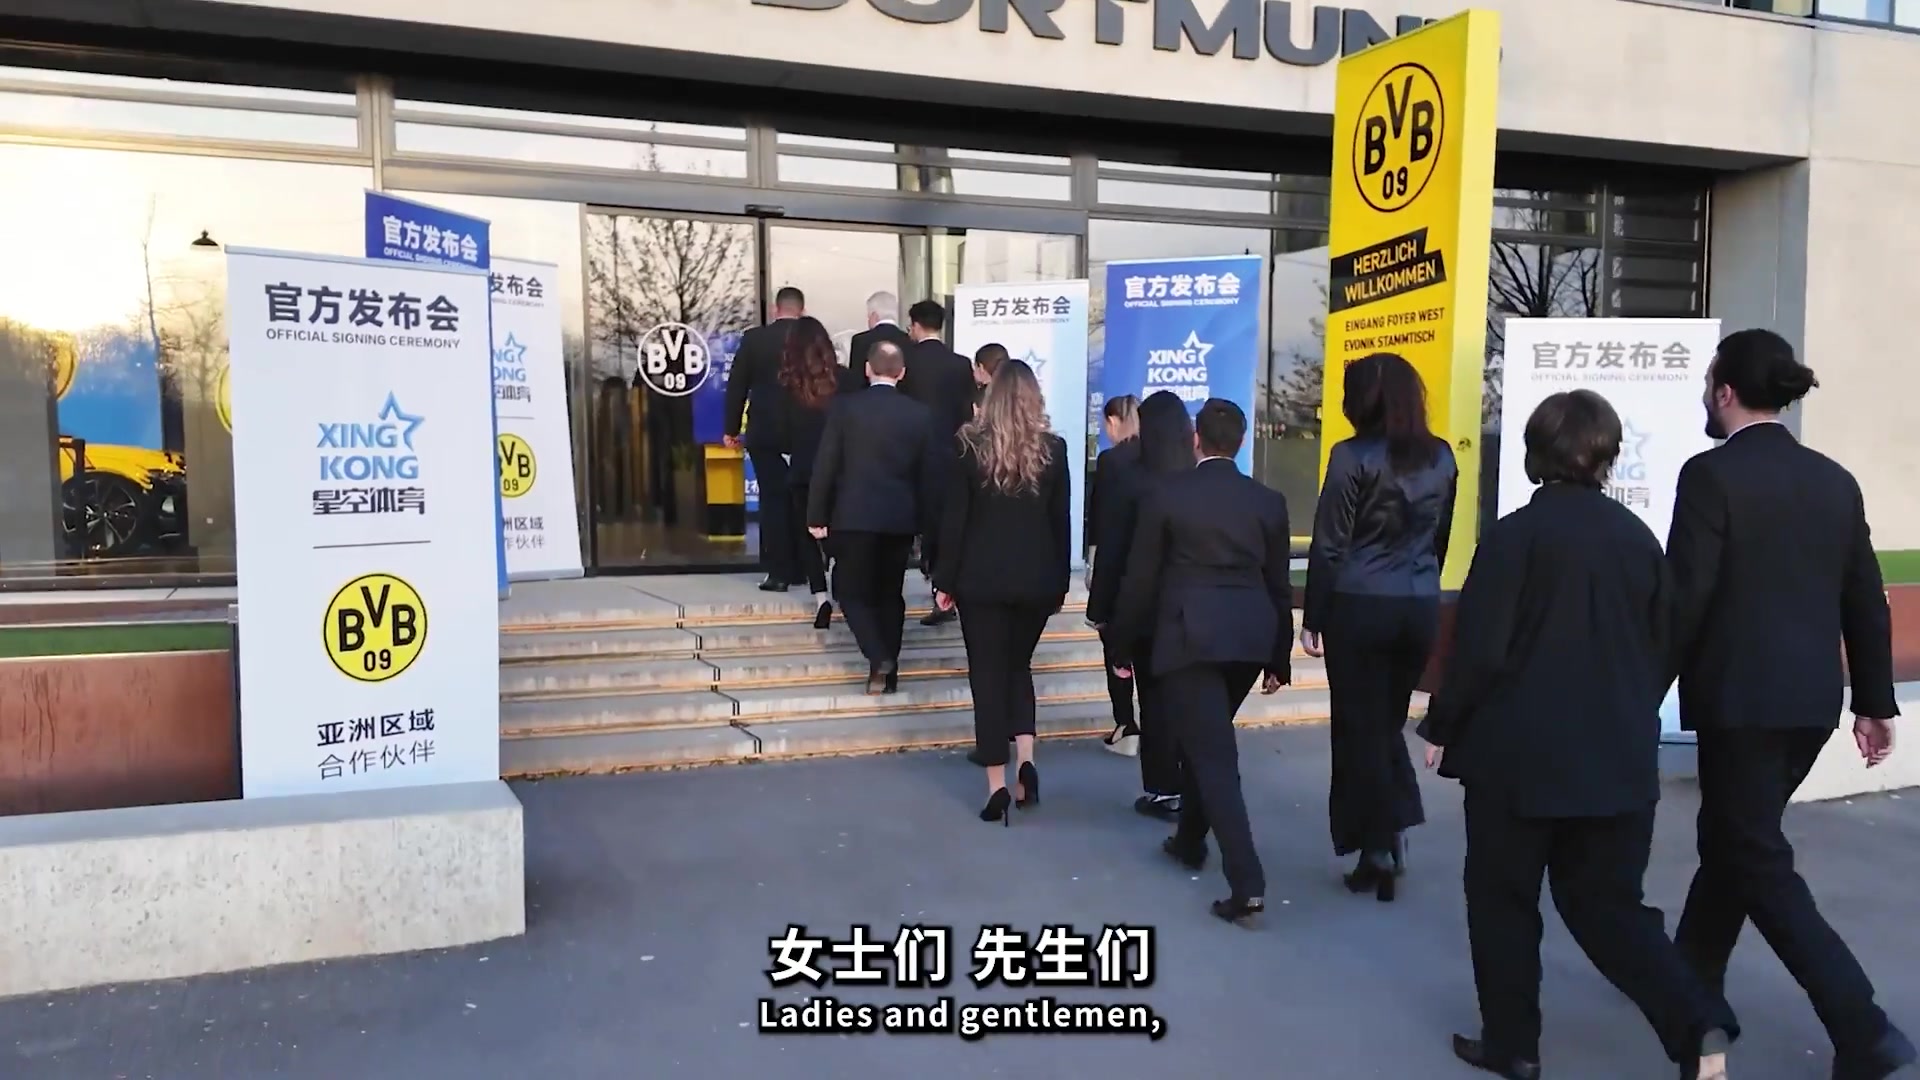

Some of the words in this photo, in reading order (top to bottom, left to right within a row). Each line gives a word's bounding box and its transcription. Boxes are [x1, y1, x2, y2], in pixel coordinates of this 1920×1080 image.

[1364, 74, 1434, 176] BVB
[1382, 166, 1408, 200] 09
[383, 215, 478, 262] 官方发布会
[1353, 239, 1417, 277] HERZLICH
[491, 272, 543, 298] 发布会
[1124, 272, 1241, 299] 官方发布会
[1344, 259, 1436, 303] WILLKOMMEN
[265, 282, 459, 332] 官方发布会
[972, 295, 1070, 317] 官方发布会
[1345, 315, 1385, 332] EINGANG
[1387, 310, 1416, 327] FOYER
[1419, 307, 1445, 322] WEST
[266, 328, 328, 342] OFFICIAL
[332, 332, 386, 345] SIGNING
[389, 336, 461, 349] CEREMONY
[646, 329, 704, 374] BVB
[1344, 336, 1376, 351] EVONIK
[1377, 330, 1435, 348] STAMMTISCH
[1147, 349, 1197, 365] XING
[1532, 341, 1691, 369] 官方发布会
[664, 373, 686, 389] 09
[1147, 367, 1208, 383] KONG
[1531, 372, 1578, 382] OFFICIAL
[1628, 372, 1689, 382] CEREMONY
[317, 423, 398, 448] XING
[320, 455, 419, 480] KONG
[499, 440, 530, 478] VB
[503, 478, 518, 491] 09
[312, 487, 425, 515] 星空体育
[338, 584, 417, 652] BVB
[364, 649, 391, 672] 09
[317, 708, 435, 746] 亚洲区域
[318, 739, 435, 780] 合作伙伴
